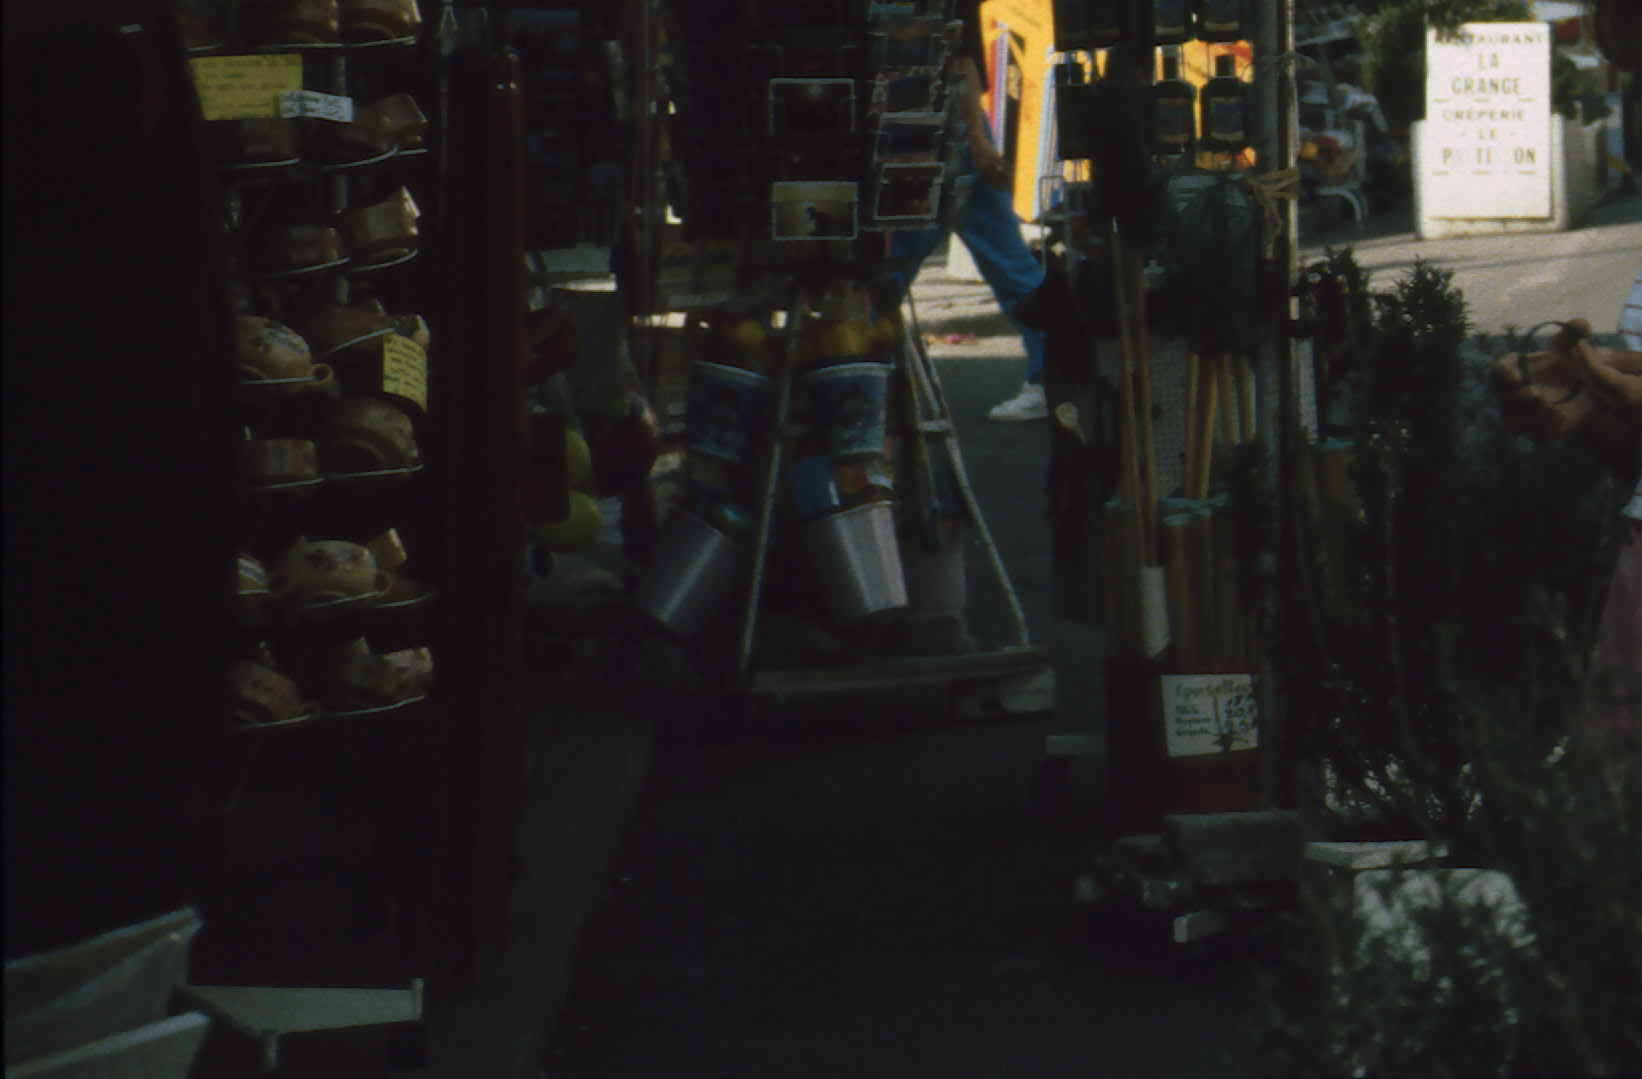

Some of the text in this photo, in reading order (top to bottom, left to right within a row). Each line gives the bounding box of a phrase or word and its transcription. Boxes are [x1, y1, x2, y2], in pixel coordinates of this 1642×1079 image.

[1478, 53, 1500, 70] LA
[1452, 76, 1520, 95] GRANGE
[1479, 128, 1498, 140] LE
